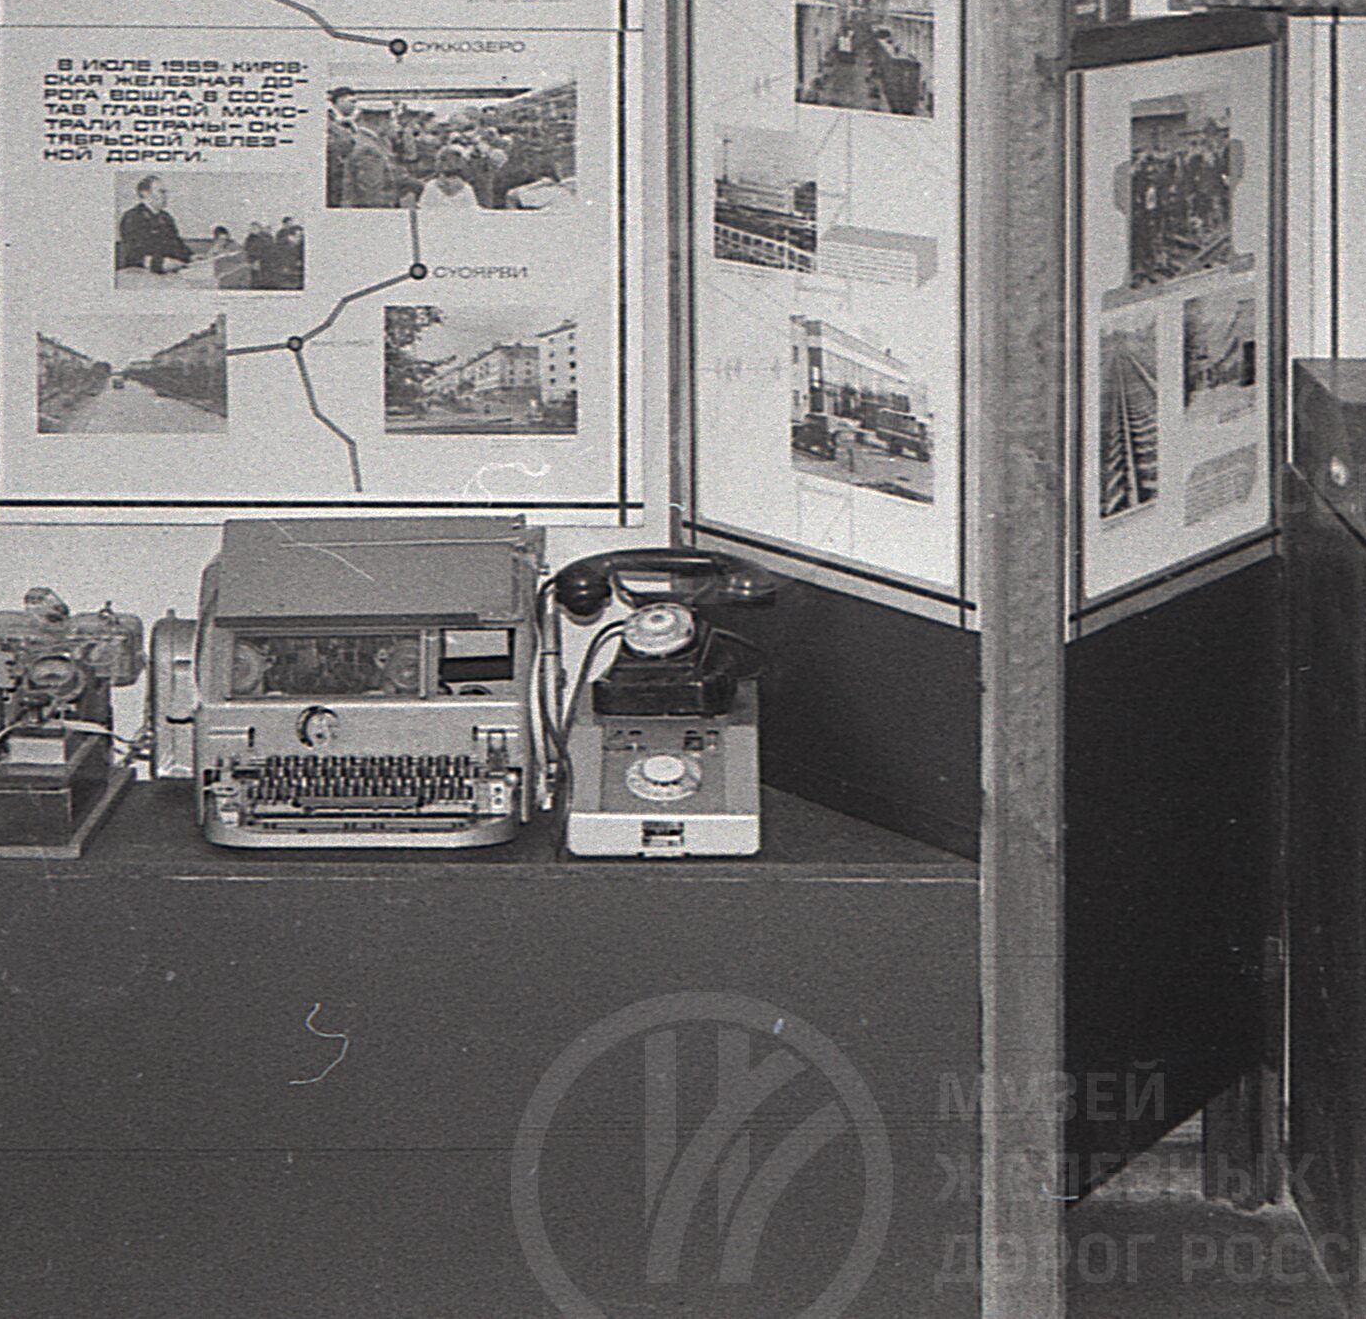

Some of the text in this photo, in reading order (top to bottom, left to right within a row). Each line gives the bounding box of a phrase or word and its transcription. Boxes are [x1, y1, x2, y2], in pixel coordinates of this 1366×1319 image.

[411, 41, 526, 53] СУККОЗЕРО
[57, 59, 73, 71] В
[82, 59, 152, 72] ИЮЛЕ
[43, 74, 103, 86] СКАЯ
[114, 75, 245, 87] ЖЕЛЕЗНАЯ
[43, 89, 99, 101] РОГА
[109, 90, 193, 102] ВОШЛА
[203, 90, 219, 103] В
[44, 104, 86, 115] ТАВ
[101, 102, 208, 117] ГЛАВНОЙ
[44, 118, 121, 131] ТРАЛИ
[44, 132, 183, 147] ТЯБРЬСКОЙ
[43, 147, 207, 163] НОЙ ДОРОГИ.
[433, 266, 528, 279] СУОЯРВИ
